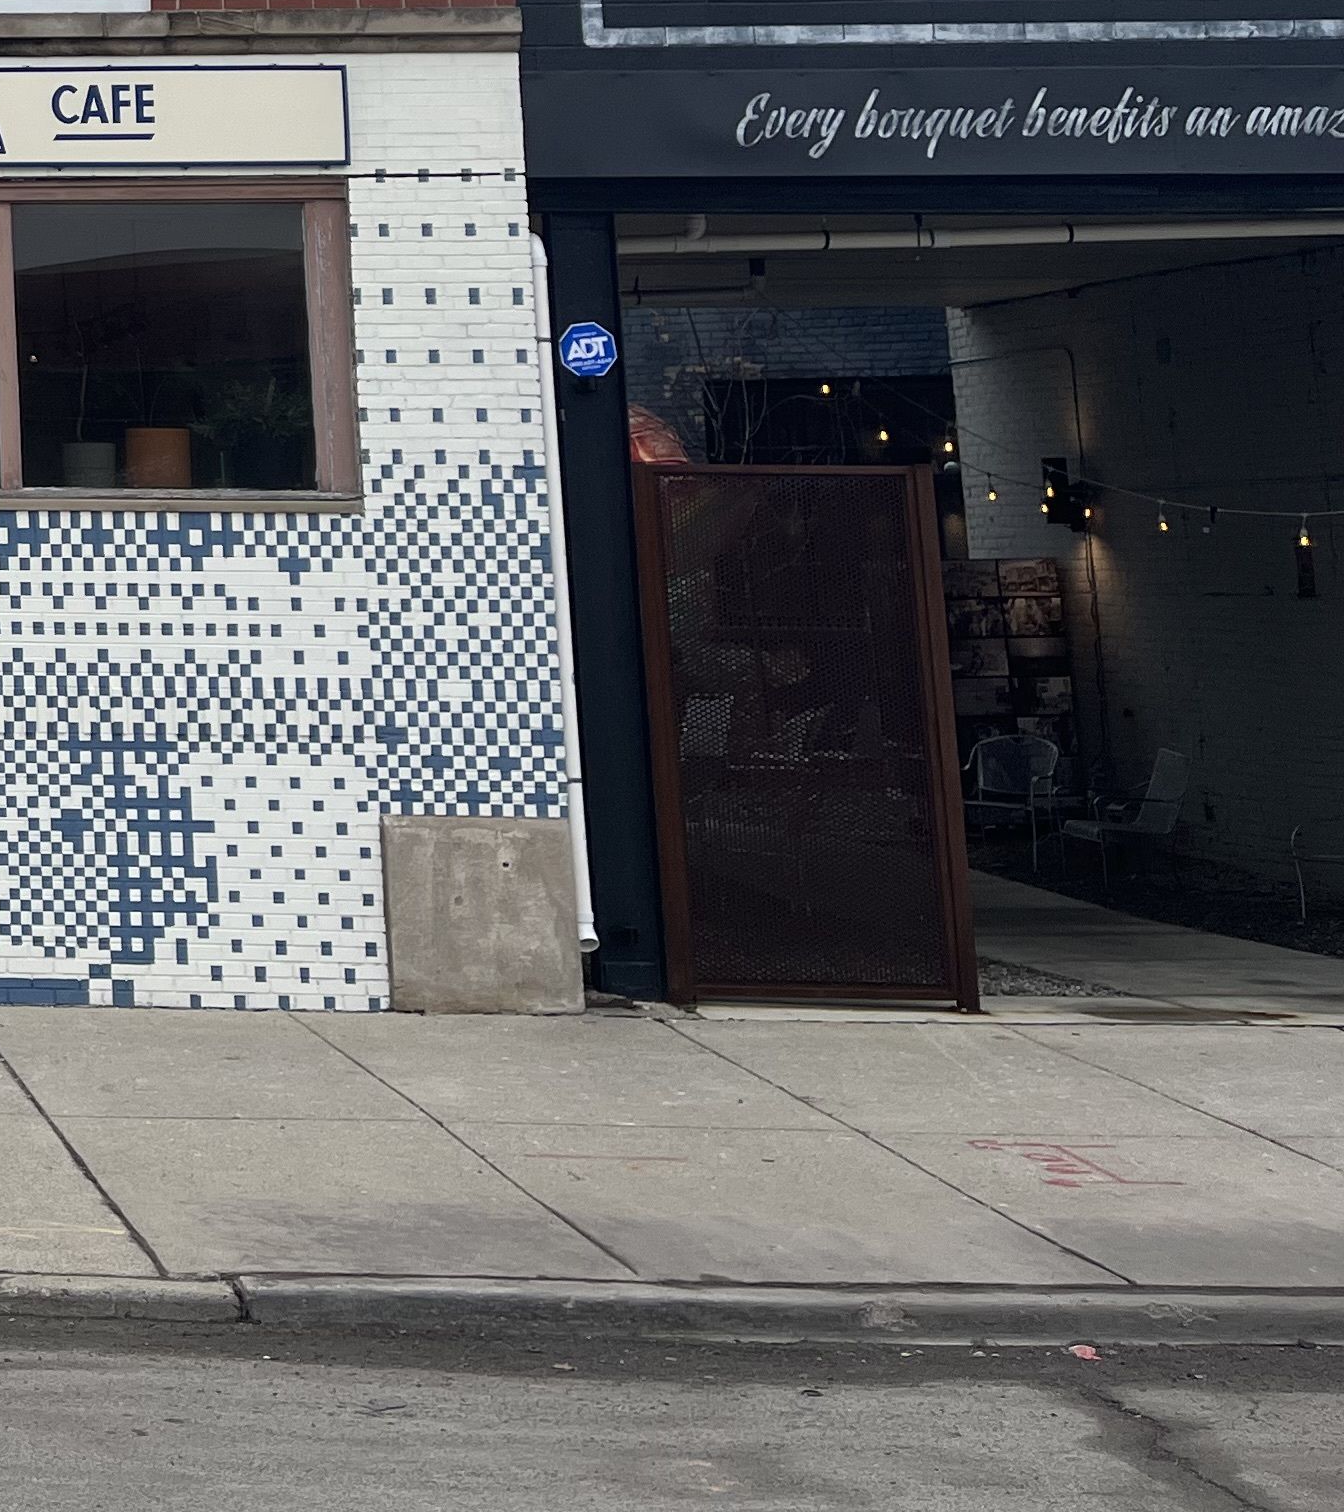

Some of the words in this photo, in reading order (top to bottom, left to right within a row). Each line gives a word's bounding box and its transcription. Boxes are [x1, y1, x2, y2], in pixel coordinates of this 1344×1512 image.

[51, 84, 156, 125] CAFE
[736, 91, 846, 159] Every
[854, 88, 1016, 159] bouquet
[1022, 87, 1178, 144] benefits
[1185, 106, 1241, 138] an
[567, 336, 608, 360] ADT
